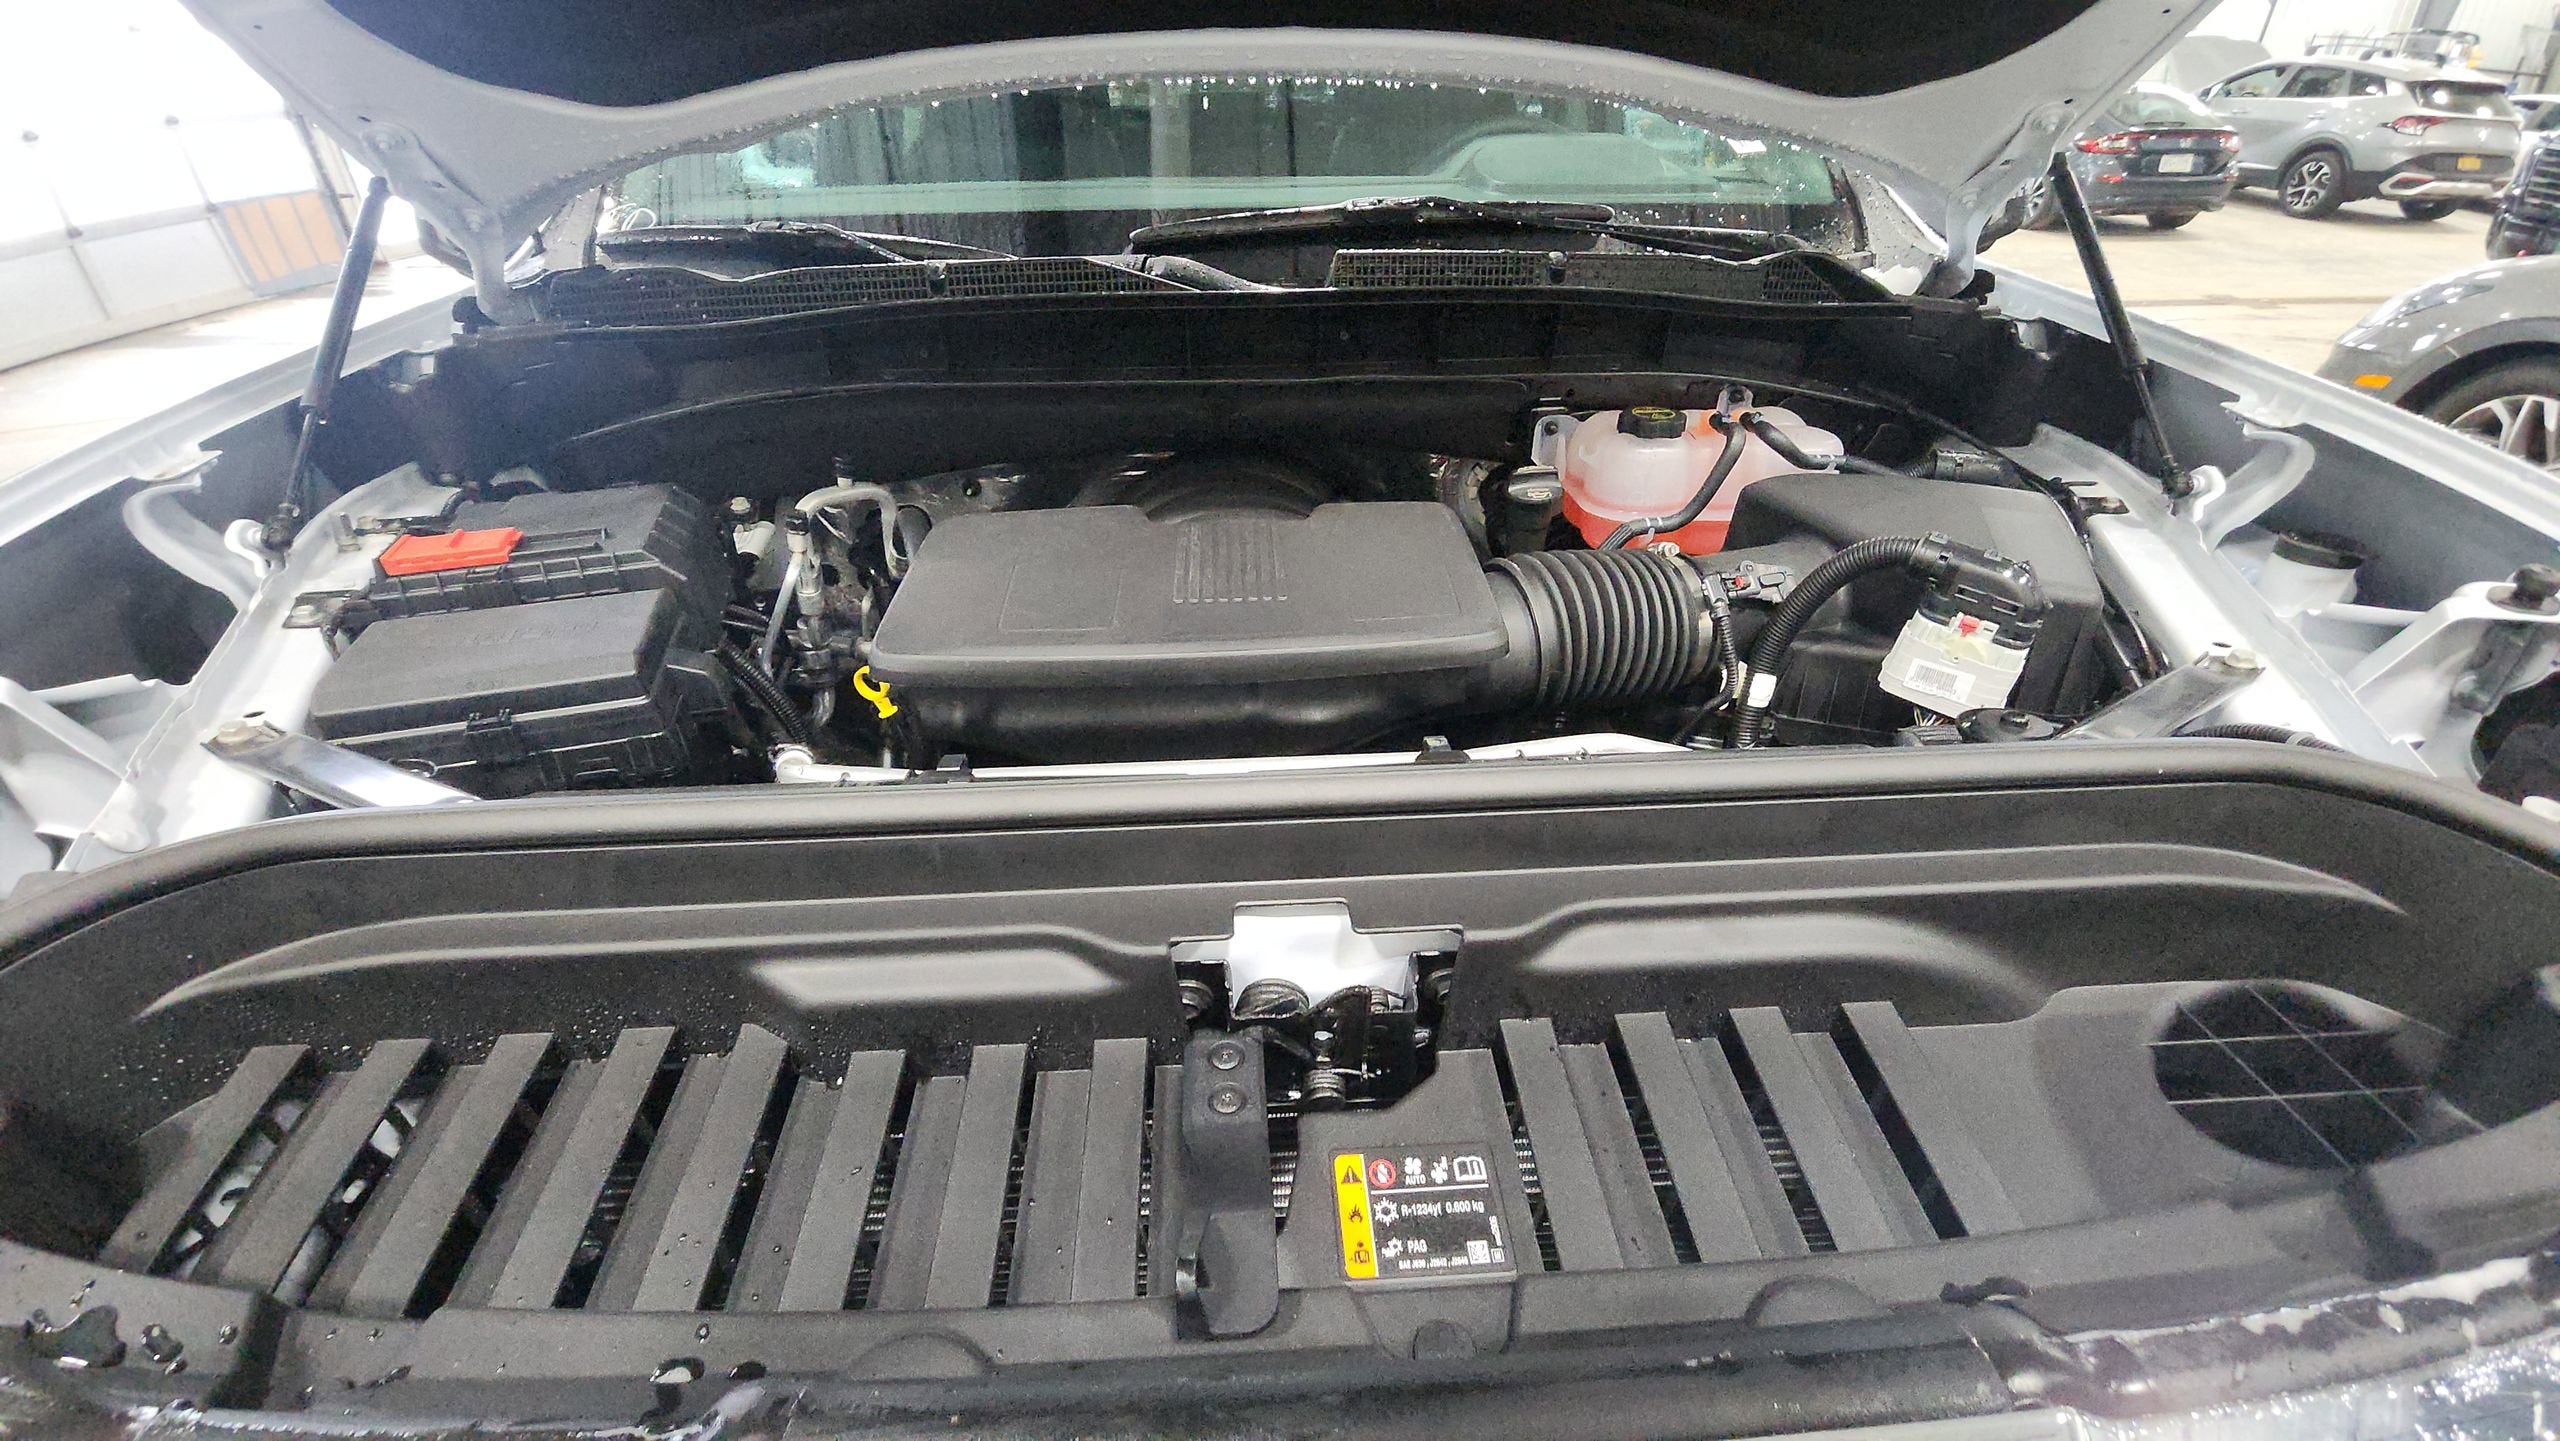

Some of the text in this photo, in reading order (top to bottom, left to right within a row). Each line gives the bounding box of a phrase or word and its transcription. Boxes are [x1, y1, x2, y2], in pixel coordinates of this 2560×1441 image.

[1405, 1173, 1426, 1186] AUTO
[1471, 1199, 1485, 1214] kg
[1407, 1238, 1428, 1254] PAG
